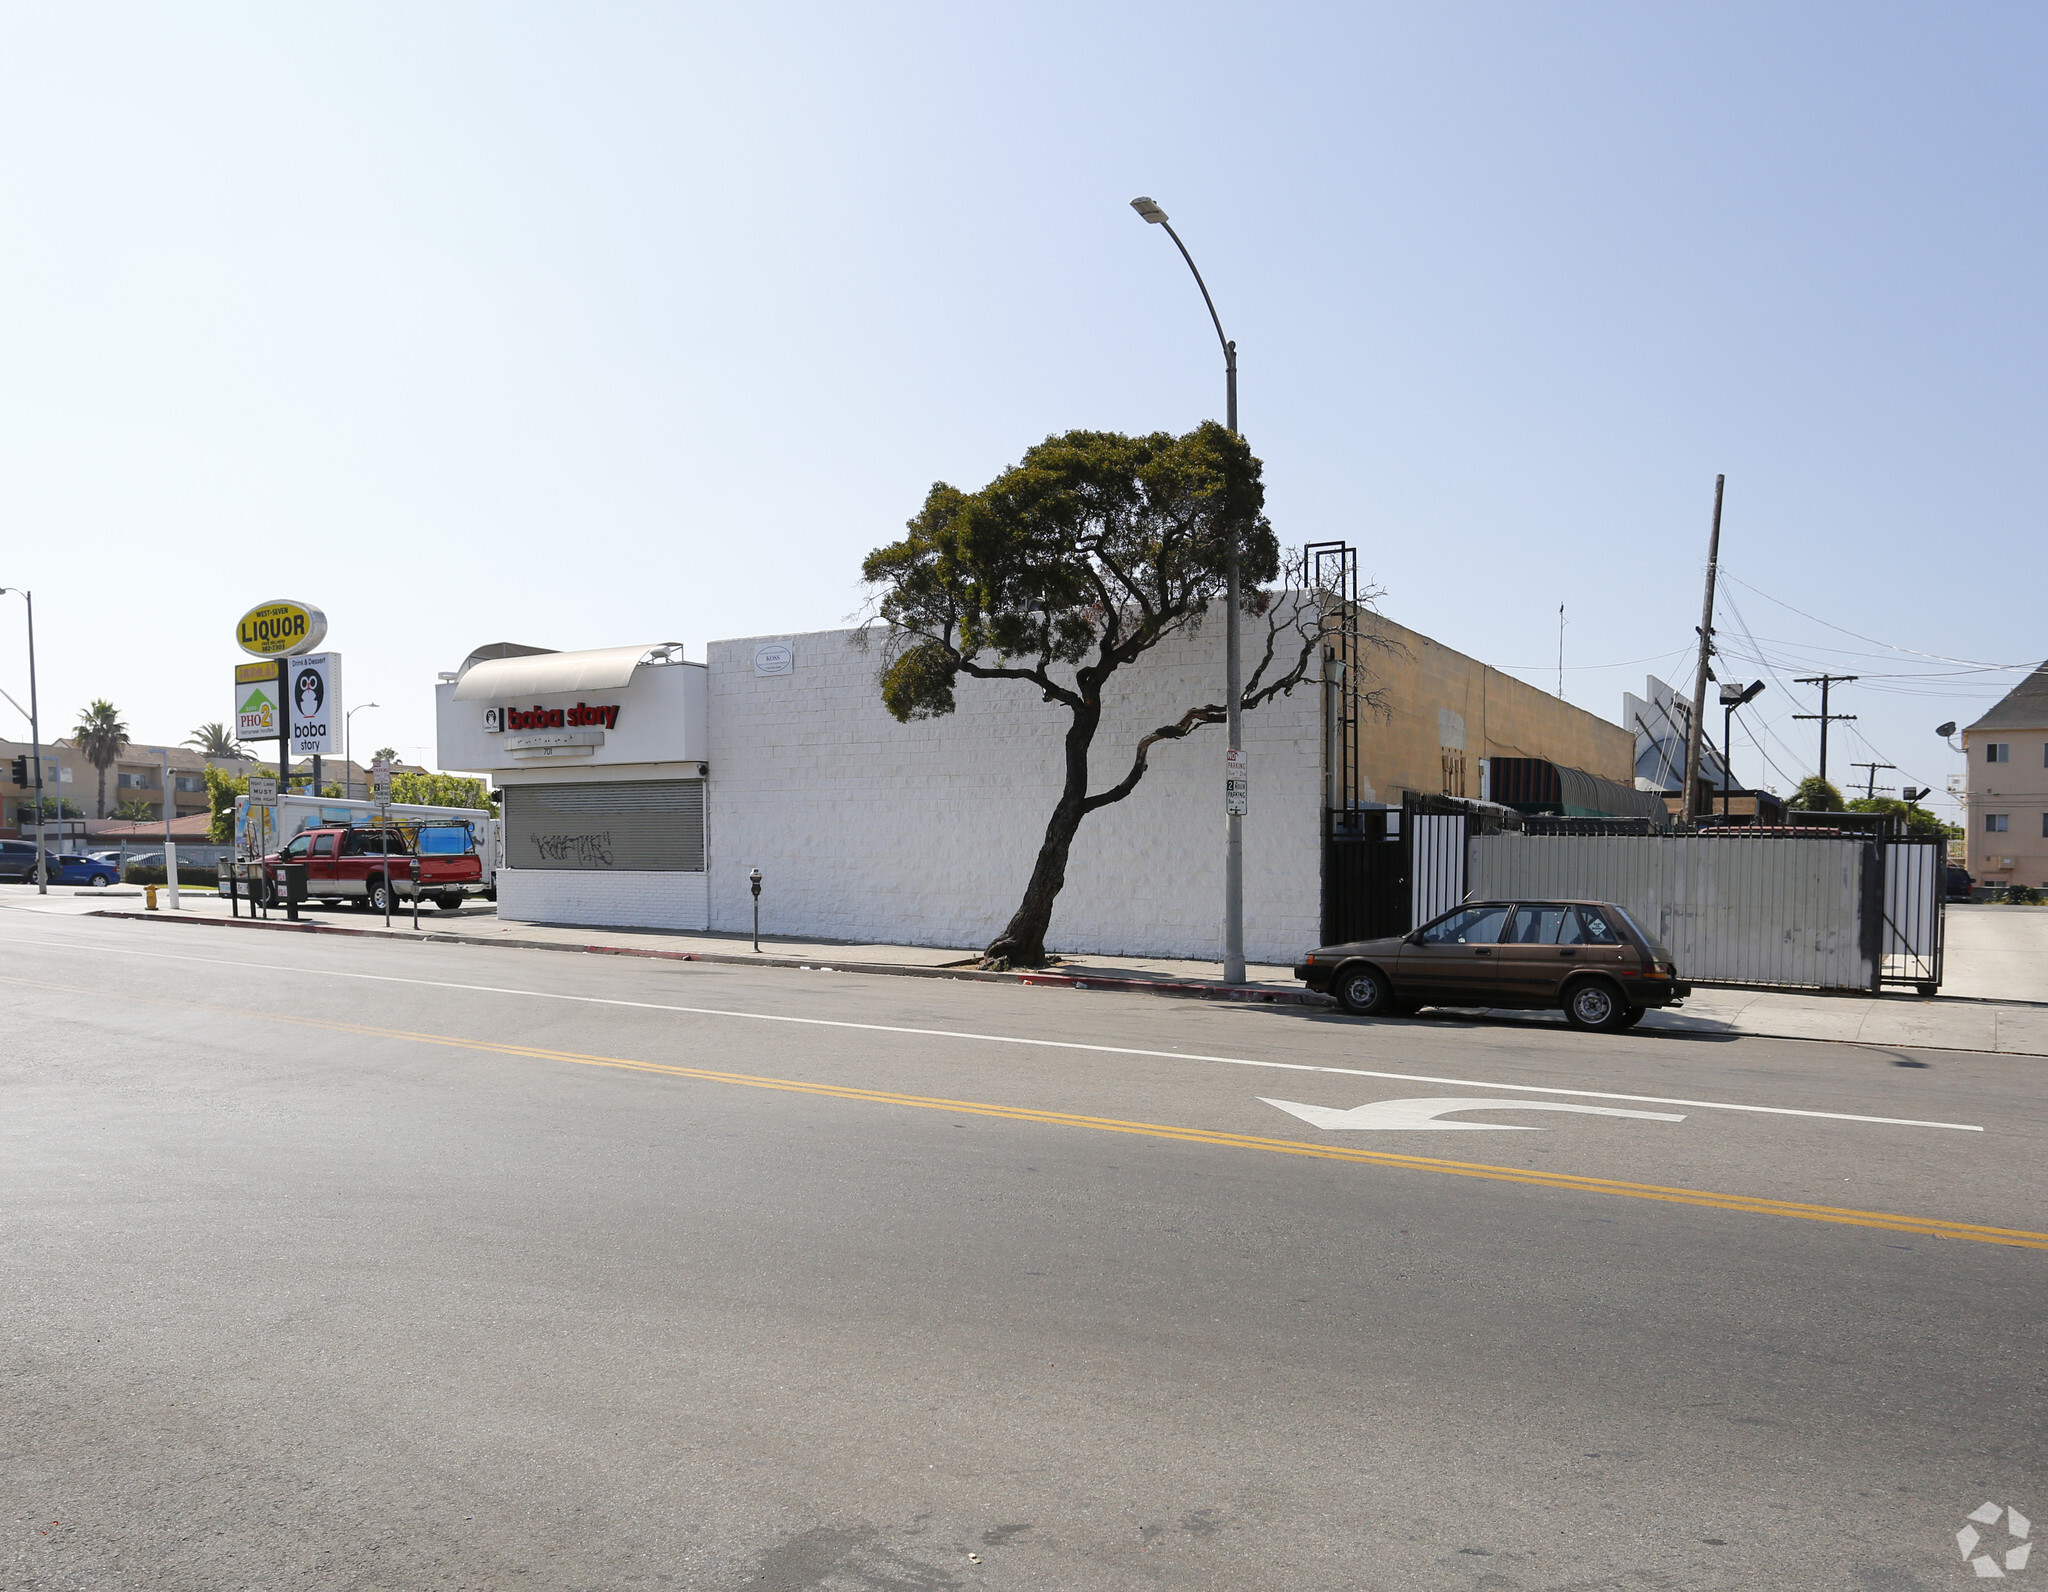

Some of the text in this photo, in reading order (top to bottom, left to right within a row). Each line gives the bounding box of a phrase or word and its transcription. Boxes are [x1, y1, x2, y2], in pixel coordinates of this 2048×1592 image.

[256, 607, 289, 618] WEST-SEVEN
[241, 614, 305, 643] LIQUOR
[308, 657, 326, 666] Dessert
[508, 702, 620, 730] boba story
[294, 722, 327, 738] boba
[300, 740, 320, 752] story
[543, 747, 553, 756] 701
[1227, 751, 1236, 760] NO
[1228, 762, 1246, 770] PARKING
[1228, 781, 1233, 790] 2
